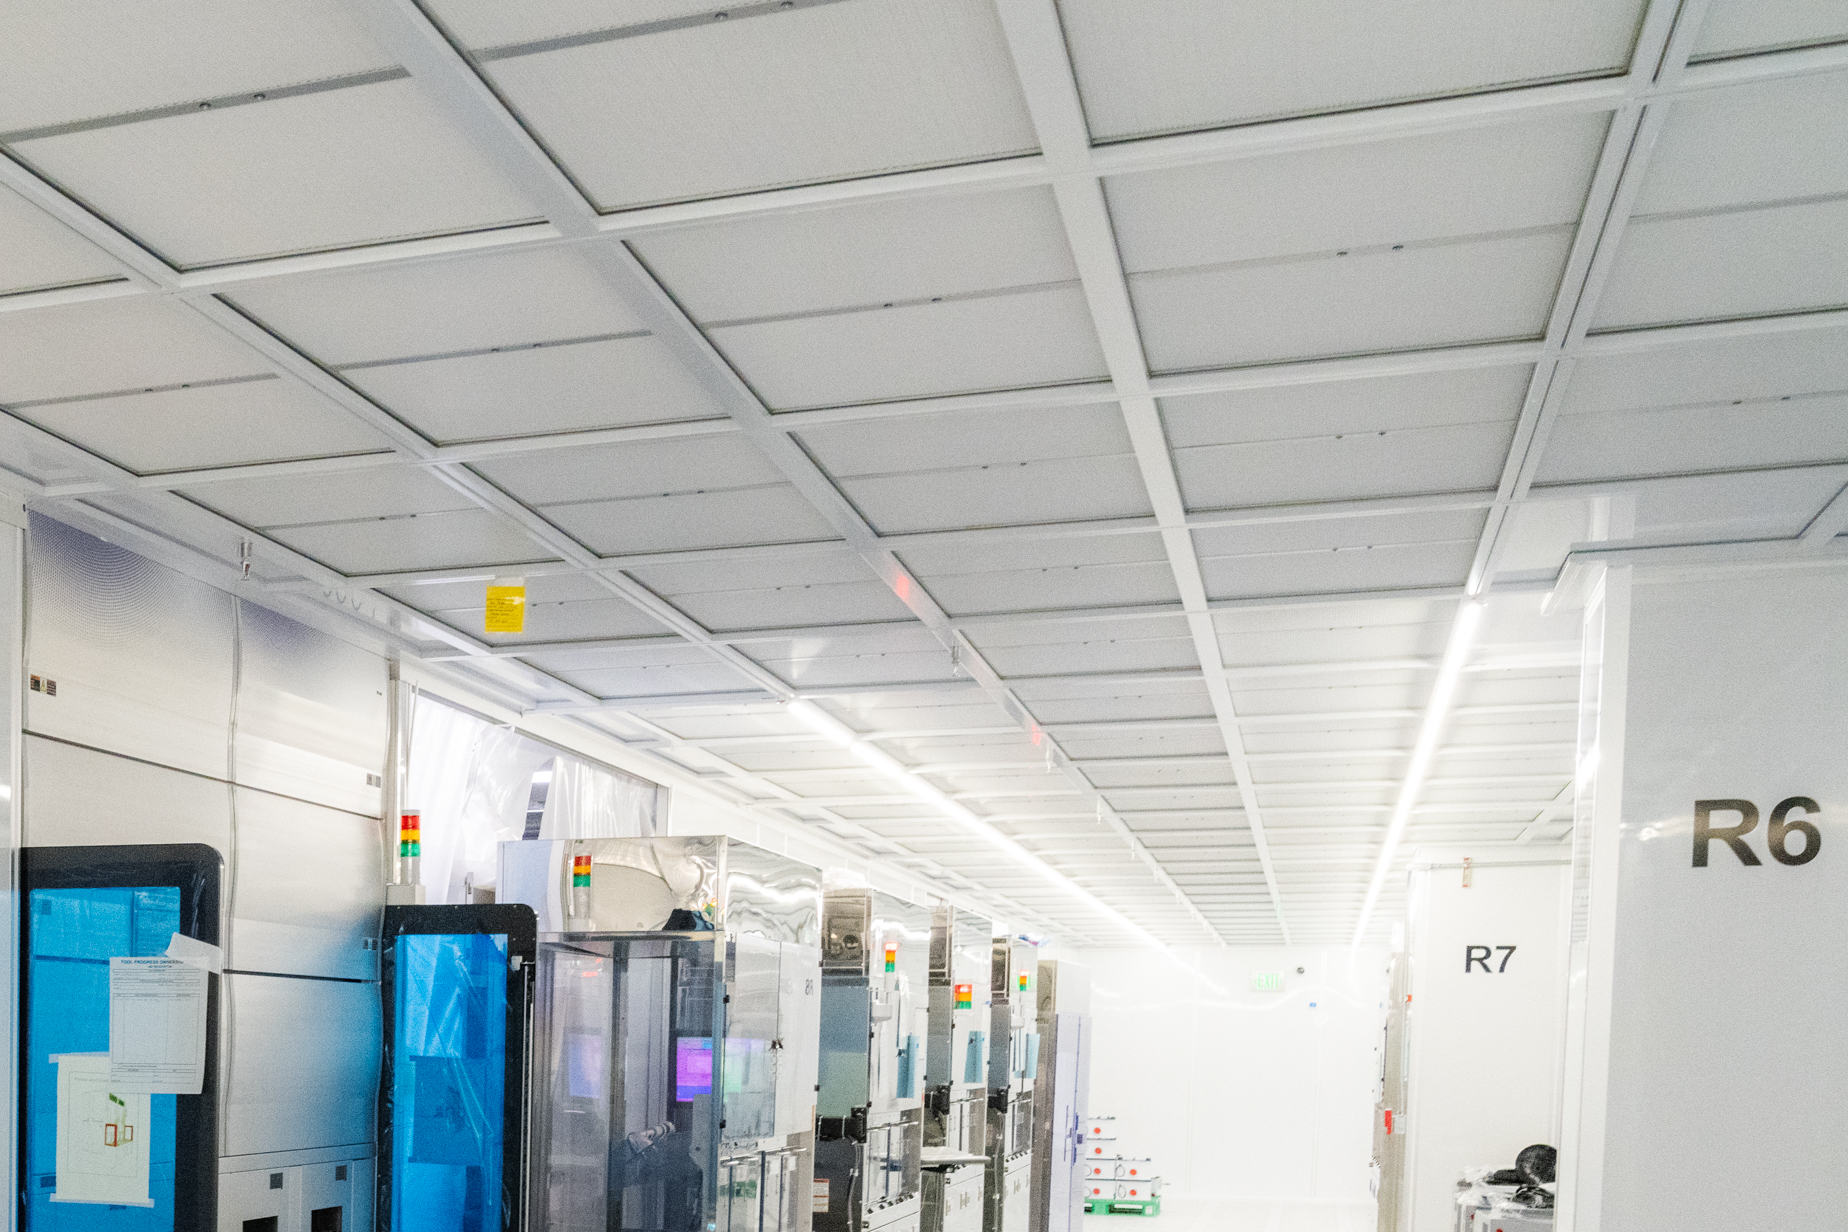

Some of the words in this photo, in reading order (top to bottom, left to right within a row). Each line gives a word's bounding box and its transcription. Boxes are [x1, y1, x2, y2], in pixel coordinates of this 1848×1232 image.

[1692, 796, 1821, 868] R6
[1465, 945, 1517, 973] R7
[1257, 974, 1279, 989] EXIT
